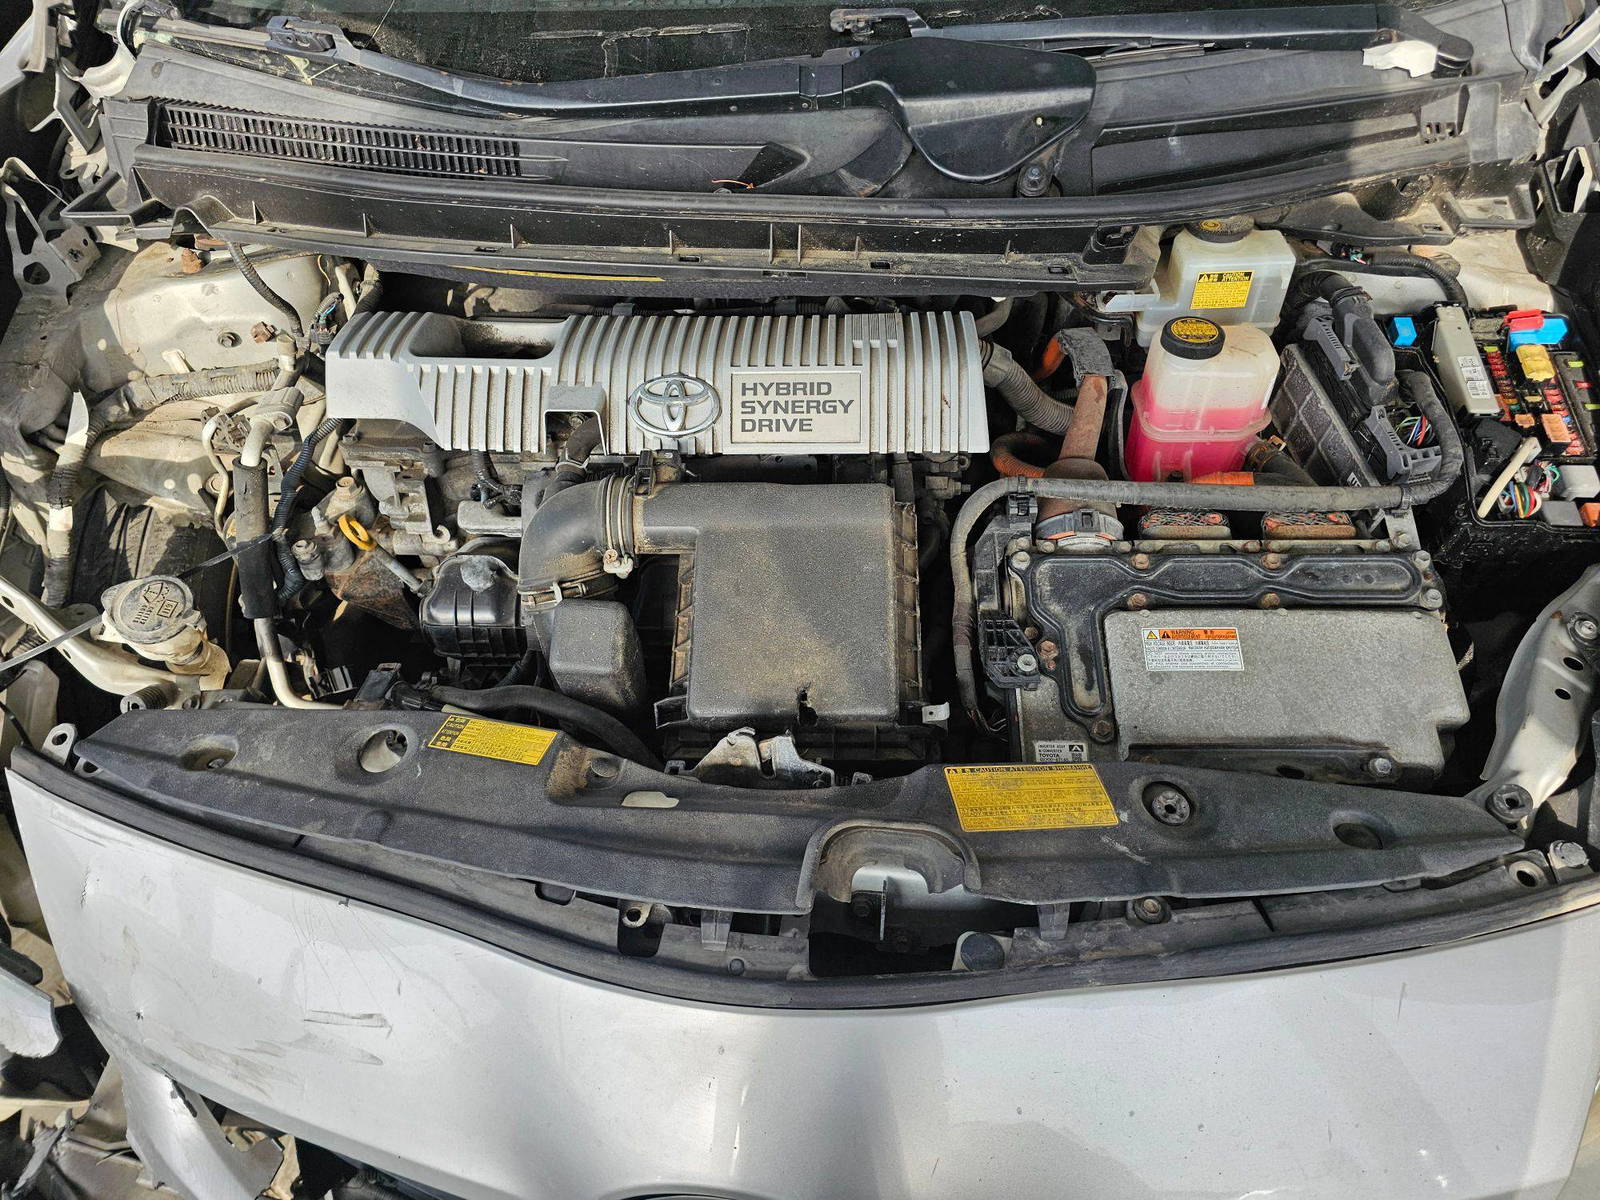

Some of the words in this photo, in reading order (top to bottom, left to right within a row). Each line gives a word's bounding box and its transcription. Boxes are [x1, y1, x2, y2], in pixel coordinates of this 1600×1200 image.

[741, 381, 832, 396] HYBRID
[740, 399, 855, 414] SYNERGY
[740, 418, 813, 432] DRIVE
